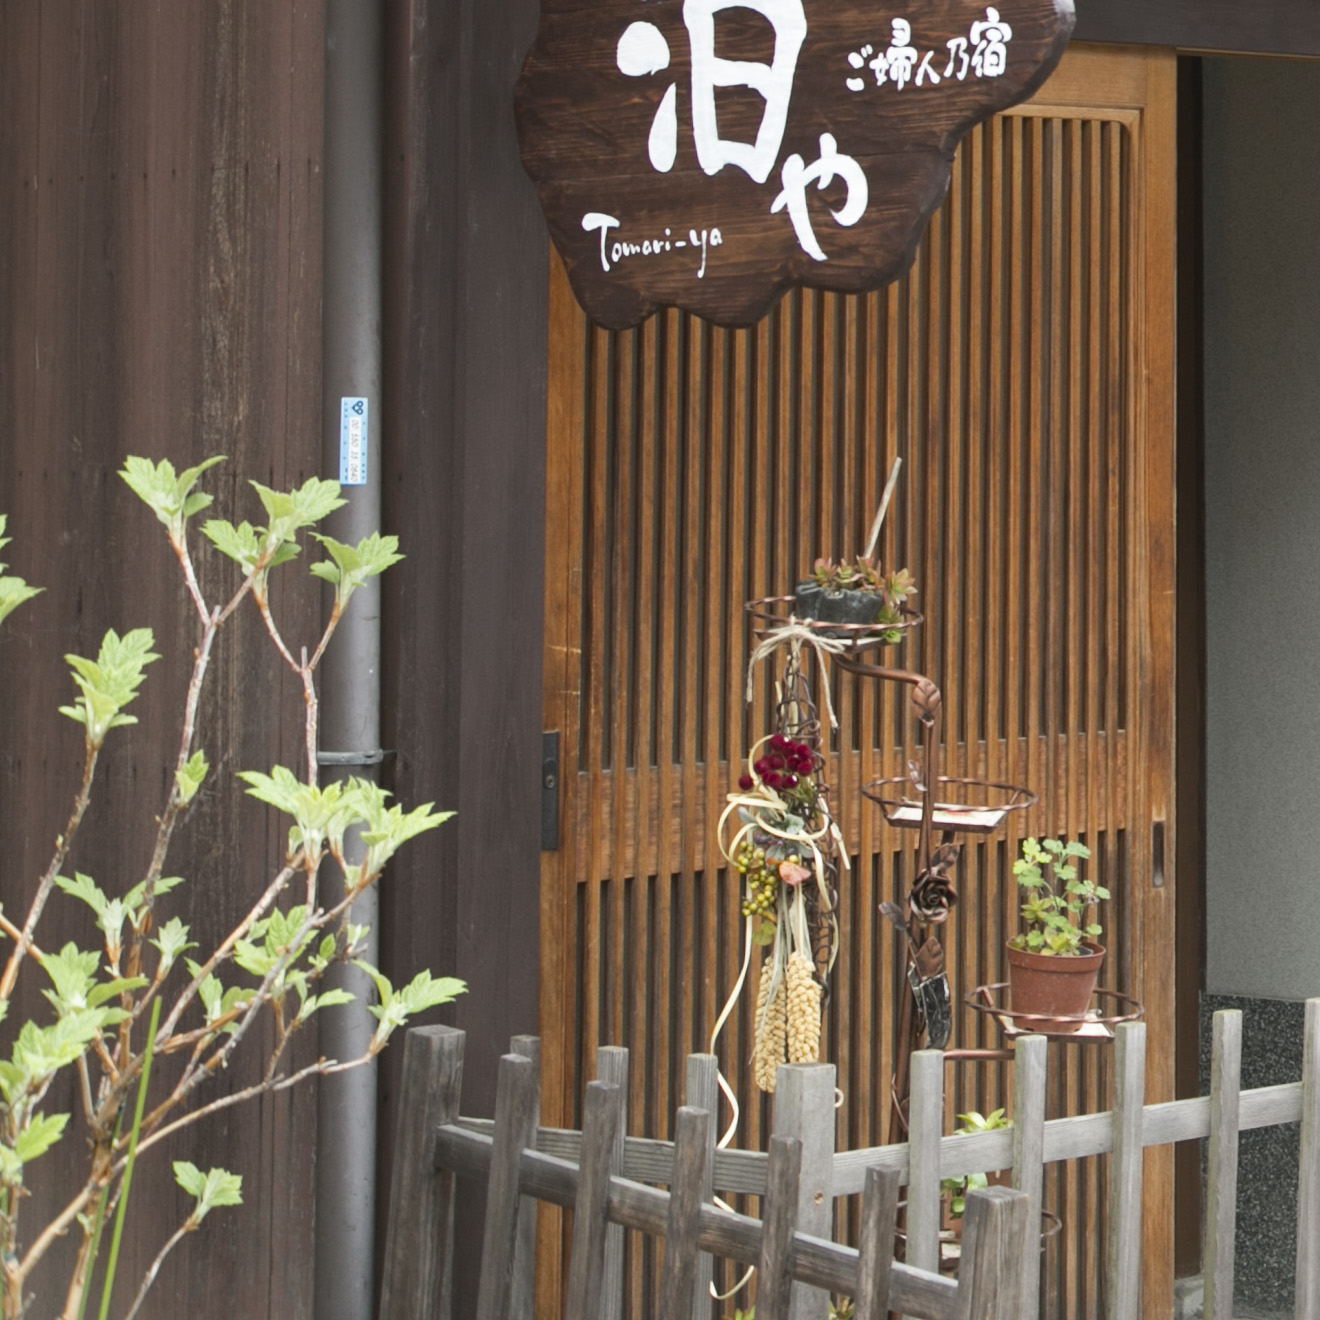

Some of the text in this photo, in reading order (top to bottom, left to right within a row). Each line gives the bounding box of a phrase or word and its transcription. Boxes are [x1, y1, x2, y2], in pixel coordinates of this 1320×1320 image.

[844, 5, 1013, 92] ご婦人乃宿
[580, 211, 724, 279] Tomari-ya
